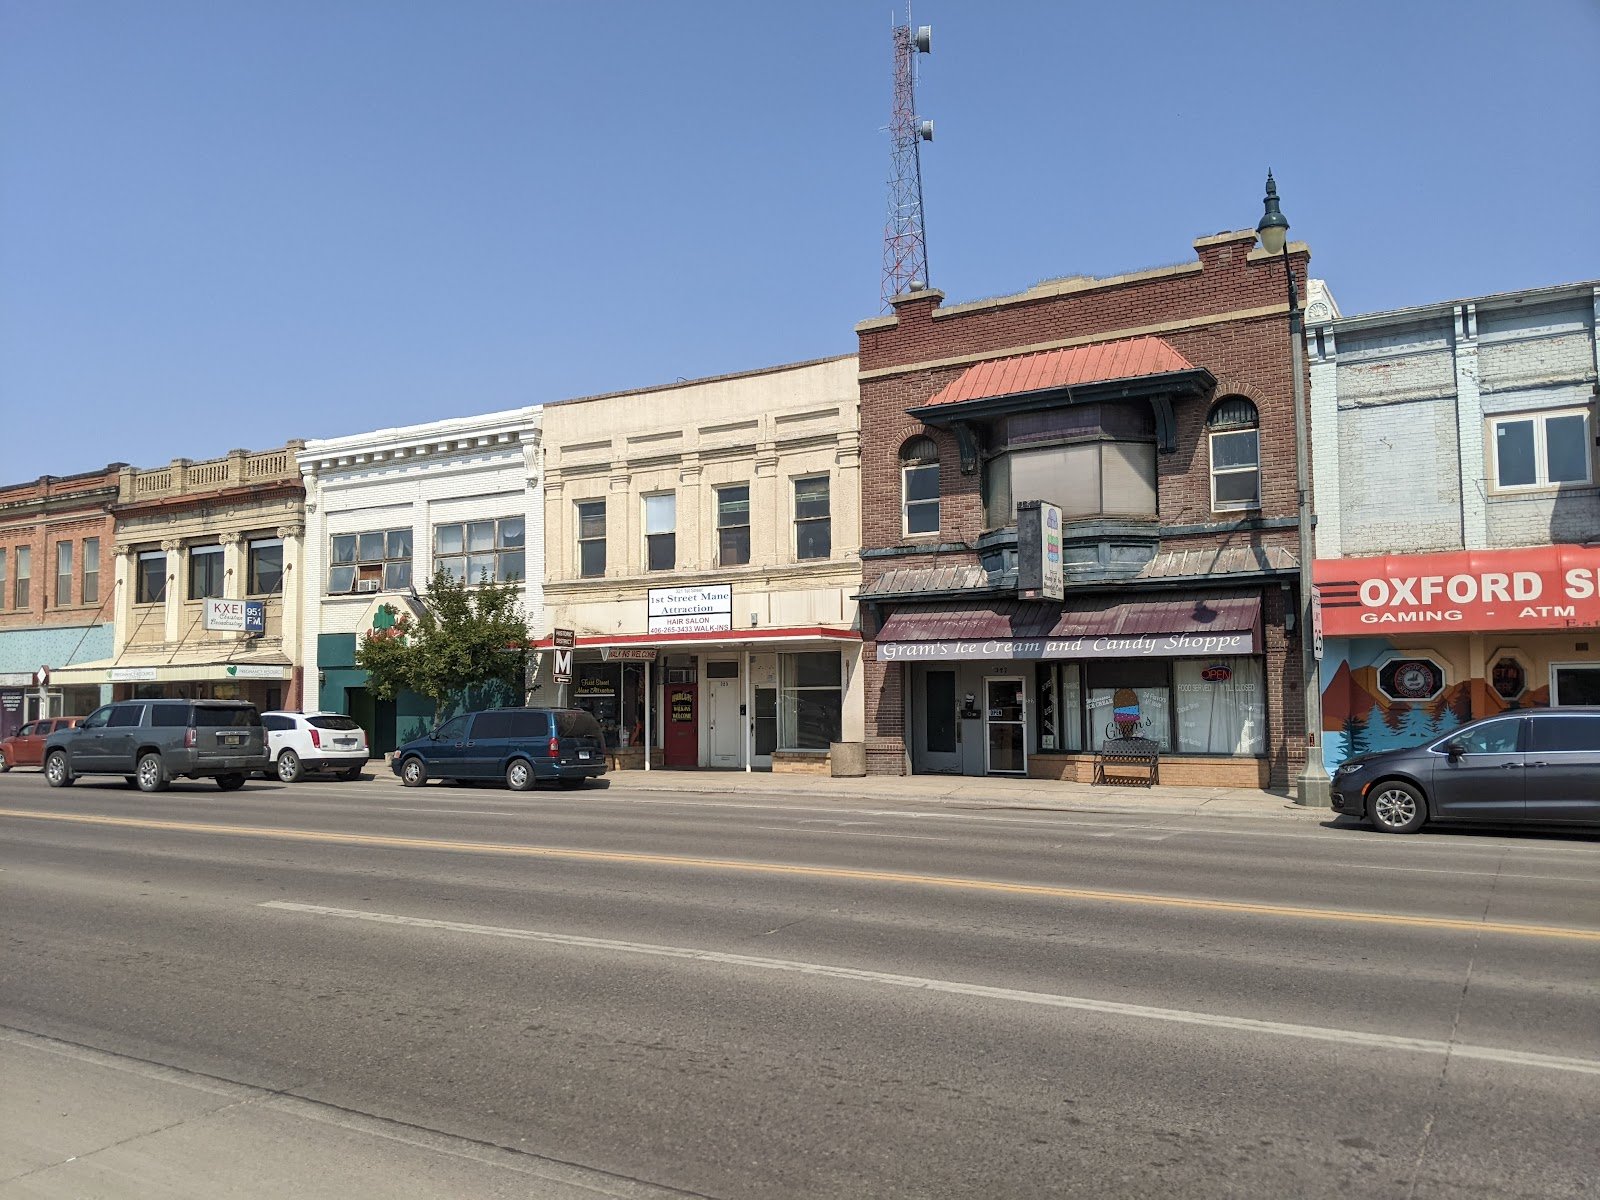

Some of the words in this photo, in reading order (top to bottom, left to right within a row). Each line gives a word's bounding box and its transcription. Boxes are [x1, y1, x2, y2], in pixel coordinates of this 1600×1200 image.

[1359, 571, 1543, 608] OXFORD
[1565, 568, 1600, 599] S
[651, 596, 664, 604] 1st
[667, 594, 697, 603] Street
[700, 592, 729, 601] Mane
[214, 603, 243, 614] KXEI
[661, 604, 714, 614] Attraction
[1360, 610, 1463, 624] GAMING
[1518, 605, 1575, 618] ATM
[247, 616, 262, 625] FM
[650, 626, 693, 634] 406-265-3433
[693, 624, 729, 632] WALK-INS
[882, 641, 949, 660] Gram's
[953, 640, 977, 654] Ice
[982, 640, 1040, 654] Cream
[1046, 636, 1086, 652] and
[1092, 634, 1158, 654] Candy
[1163, 632, 1241, 653] Shoppe
[631, 650, 656, 658] WELCOME
[555, 650, 571, 674] M
[1201, 669, 1232, 681] OPEN
[1177, 683, 1191, 692] FOOD
[1192, 683, 1211, 692] SERVED
[1235, 683, 1255, 692] CLOSED
